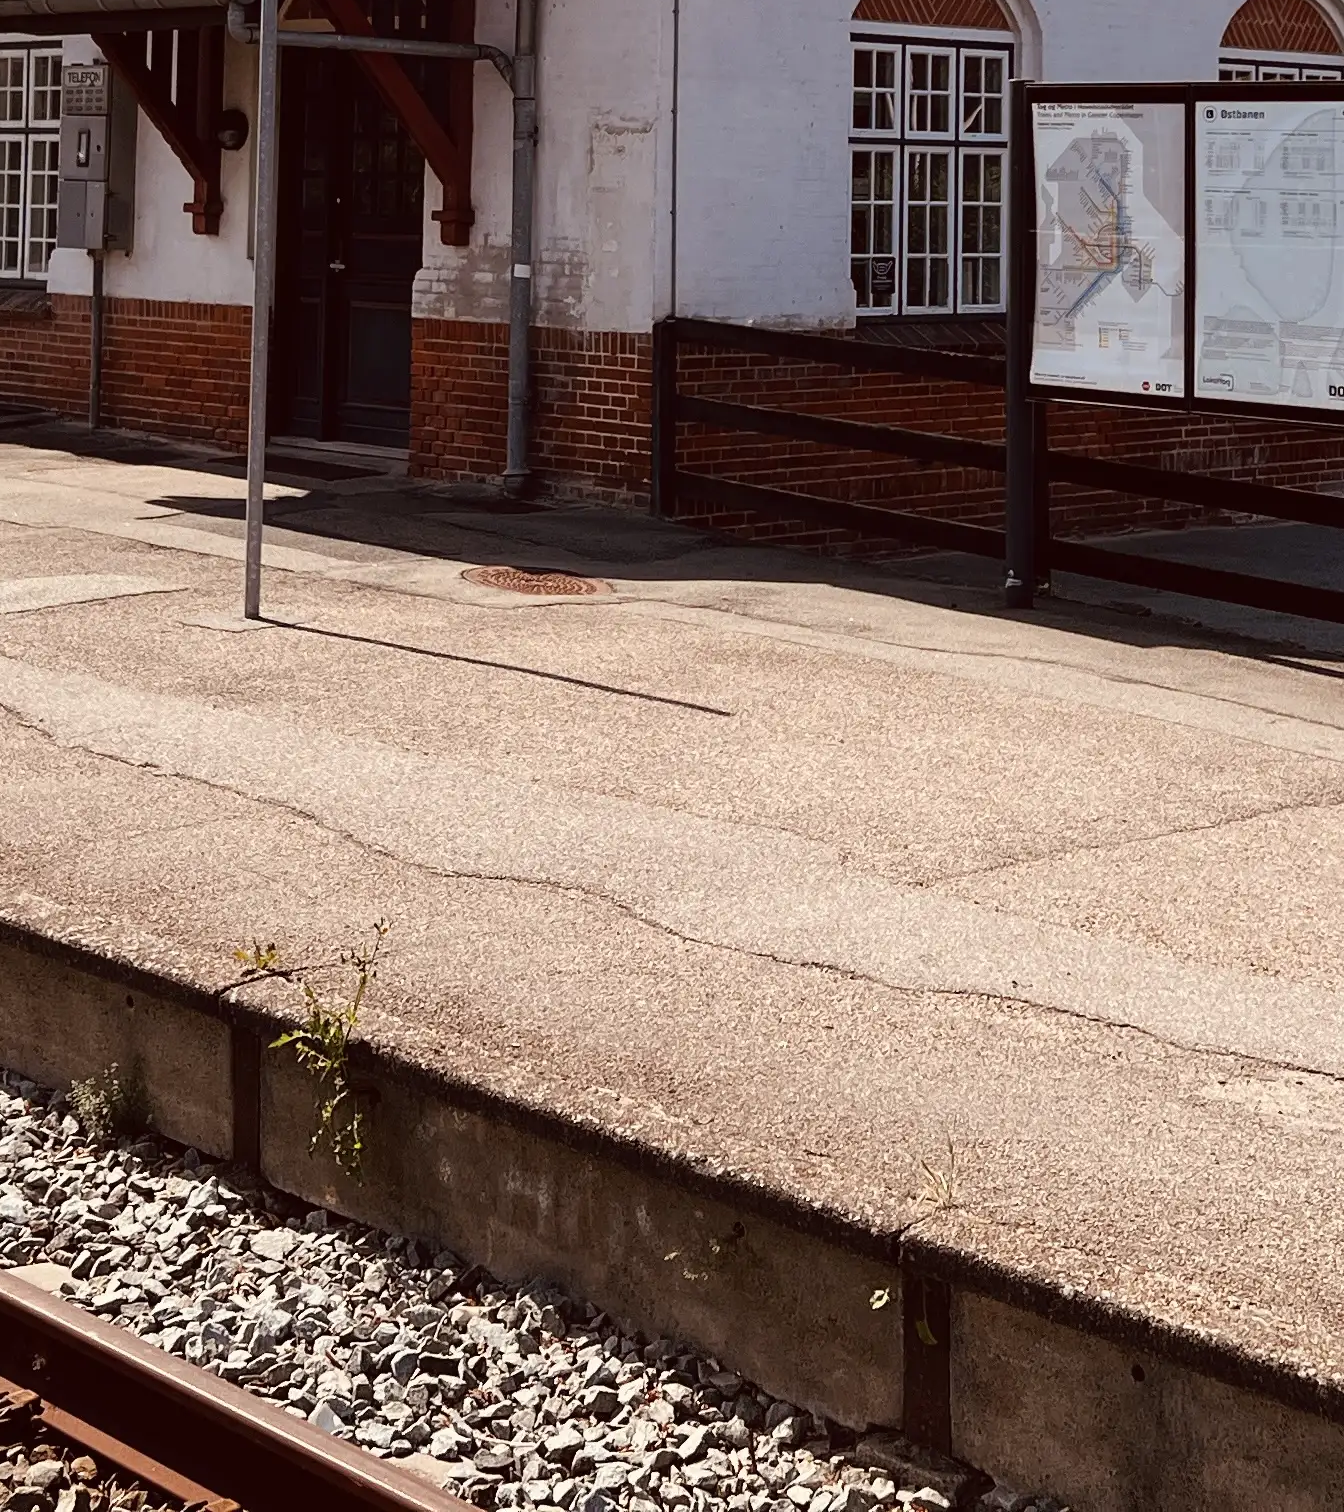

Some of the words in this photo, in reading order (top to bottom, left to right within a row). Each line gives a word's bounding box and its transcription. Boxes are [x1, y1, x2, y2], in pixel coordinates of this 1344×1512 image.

[67, 71, 101, 84] TELEFON
[1220, 109, 1265, 120] Østbanen
[1155, 383, 1172, 393] DOT
